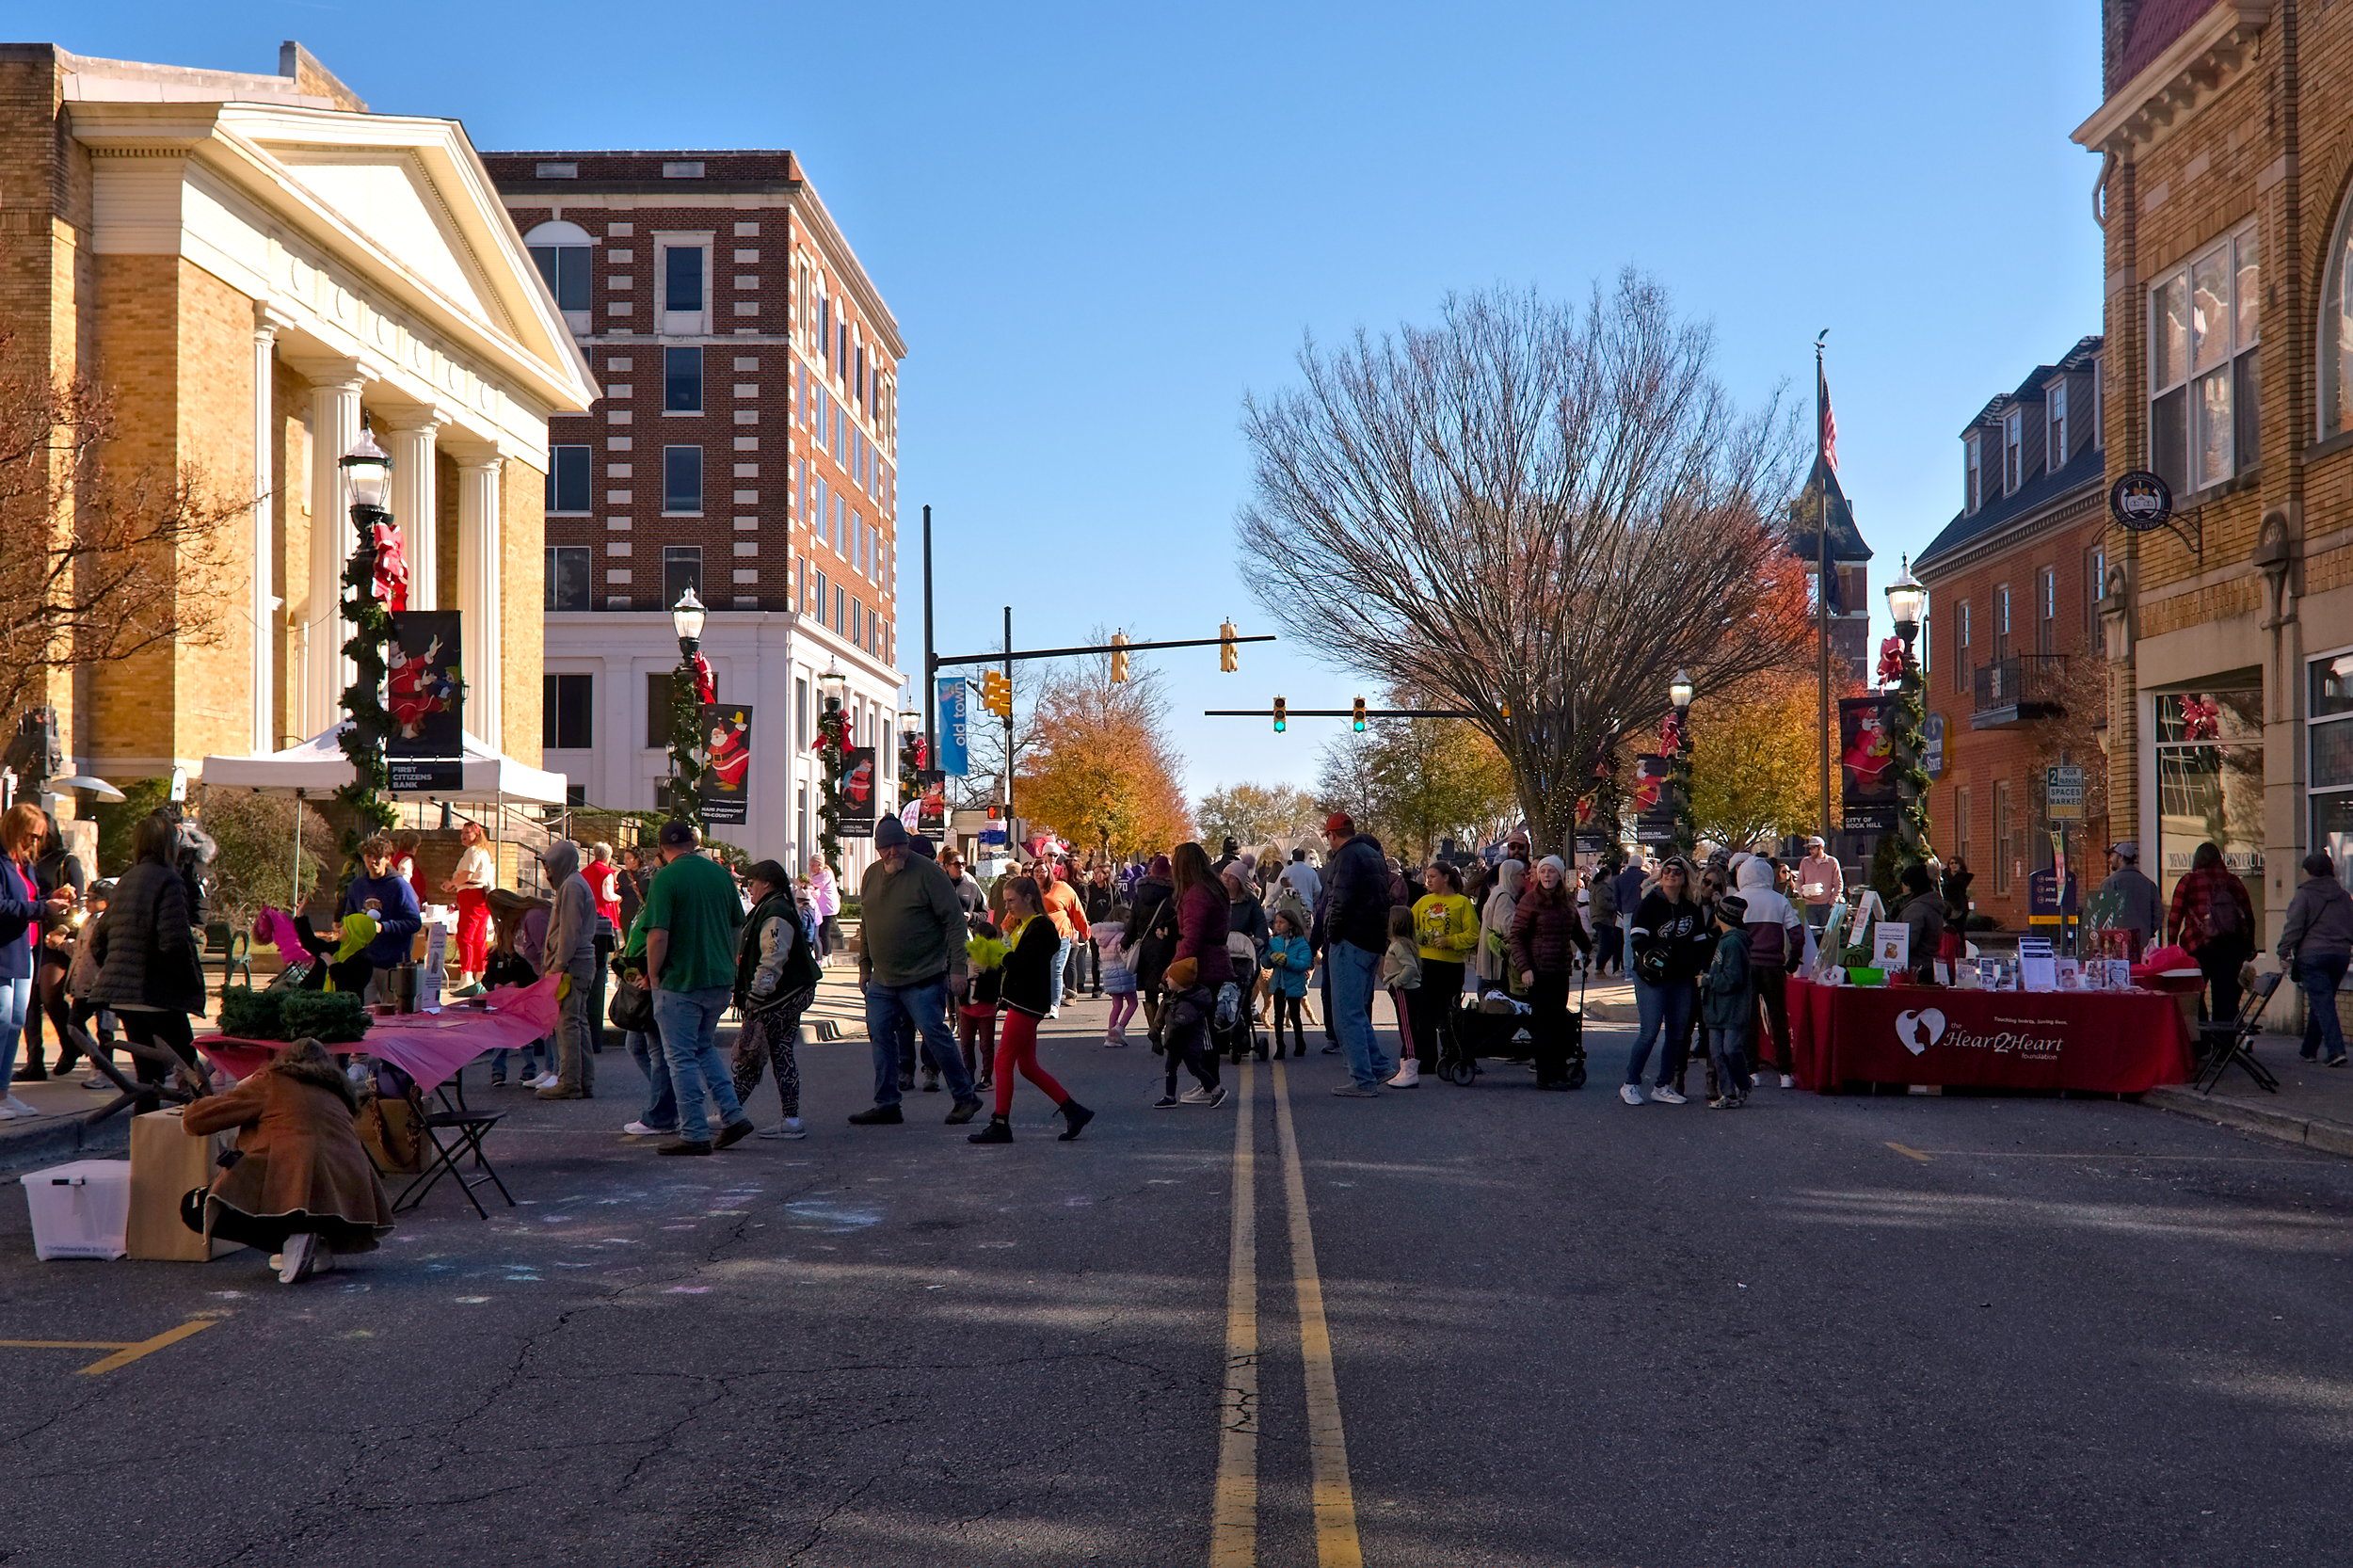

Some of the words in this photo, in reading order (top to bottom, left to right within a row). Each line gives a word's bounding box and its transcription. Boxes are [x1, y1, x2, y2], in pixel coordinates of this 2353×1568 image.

[952, 681, 965, 718] town
[952, 724, 966, 746] old
[2050, 770, 2057, 784] 2
[2050, 788, 2080, 796] SPACES
[2049, 797, 2082, 806] MARKED
[2021, 1052, 2058, 1061] foundation
